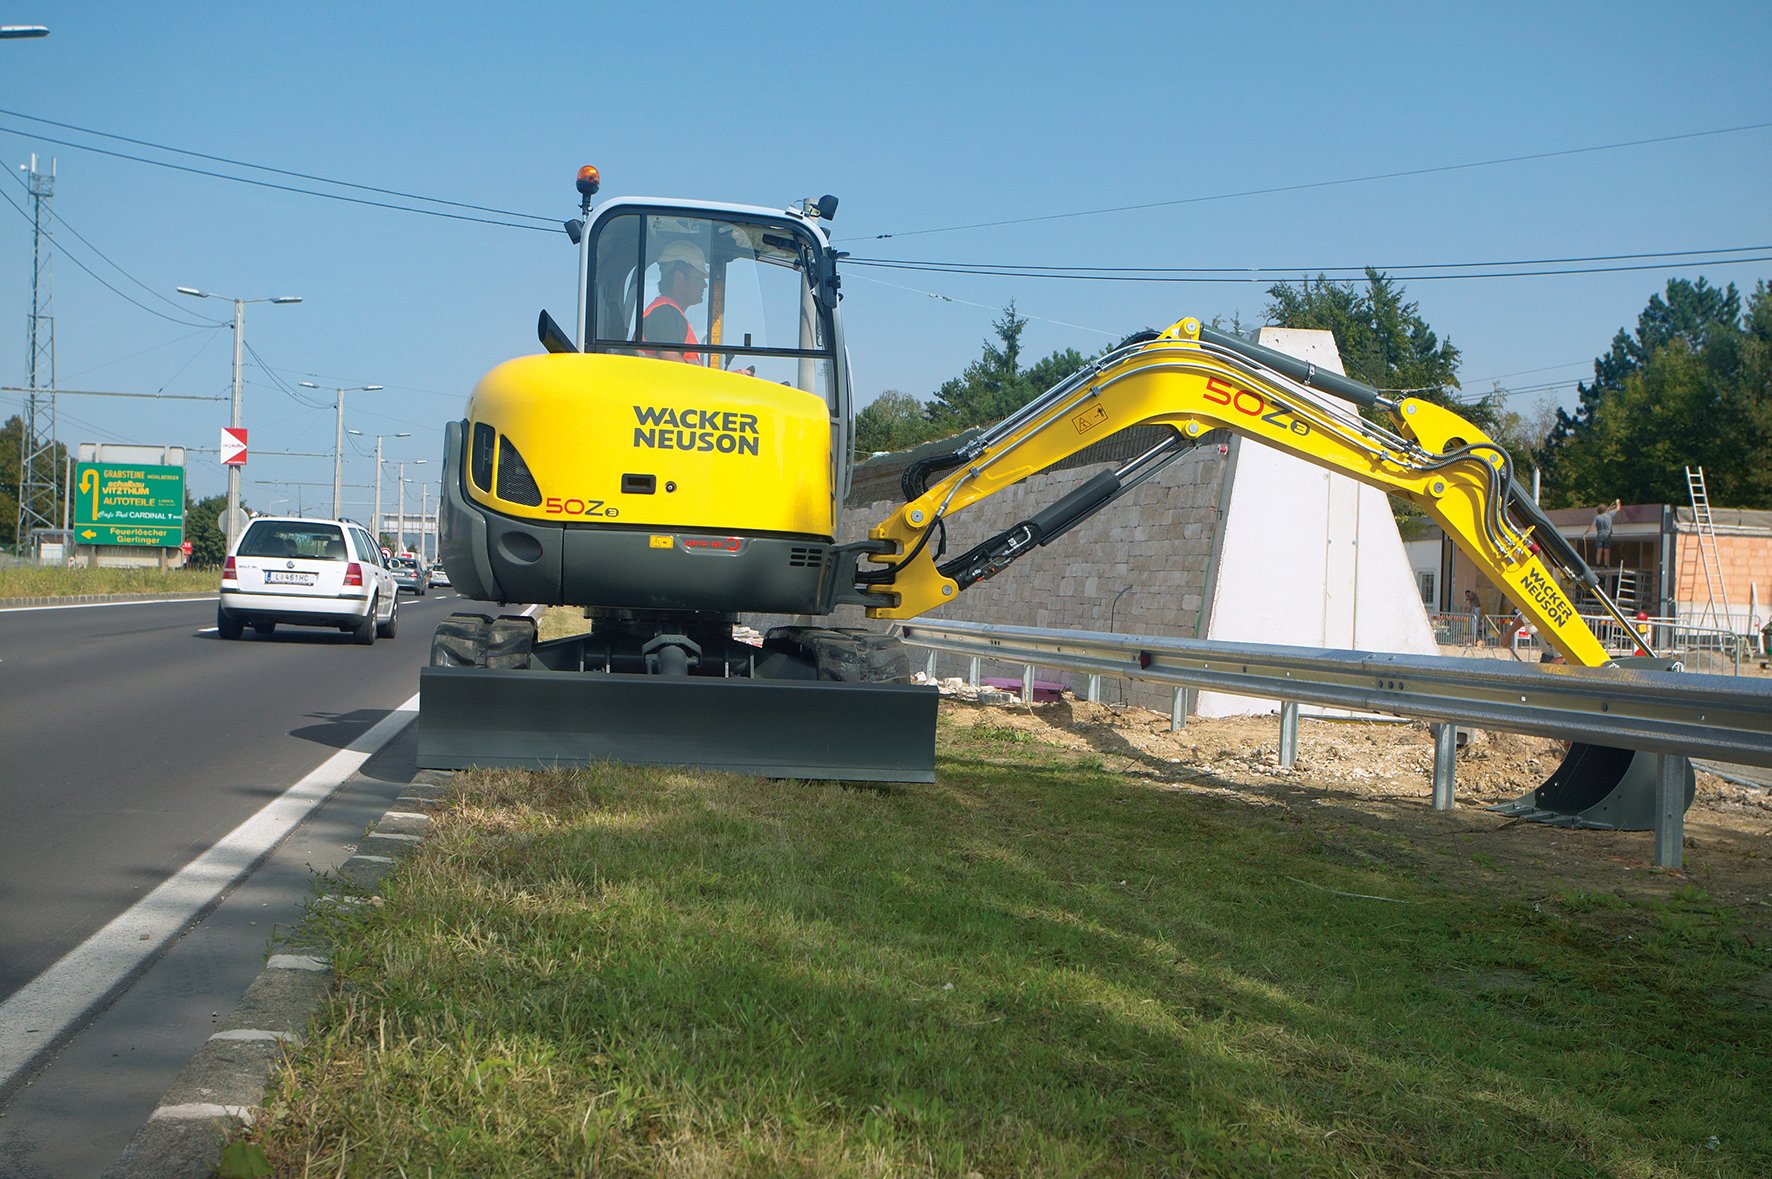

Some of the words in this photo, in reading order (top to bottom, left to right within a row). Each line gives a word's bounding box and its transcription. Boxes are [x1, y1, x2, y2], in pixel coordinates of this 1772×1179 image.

[633, 405, 760, 434] WACKER
[633, 428, 760, 456] NEUSON
[102, 487, 150, 495] VITZTHUM
[103, 497, 155, 507] AUTOTEILE
[129, 511, 167, 519] CARDINAL
[109, 527, 167, 537] Feuerlöscher
[117, 536, 160, 545] Gierlinger
[1529, 567, 1573, 620] WACKER
[1520, 575, 1568, 628] NEUSON
